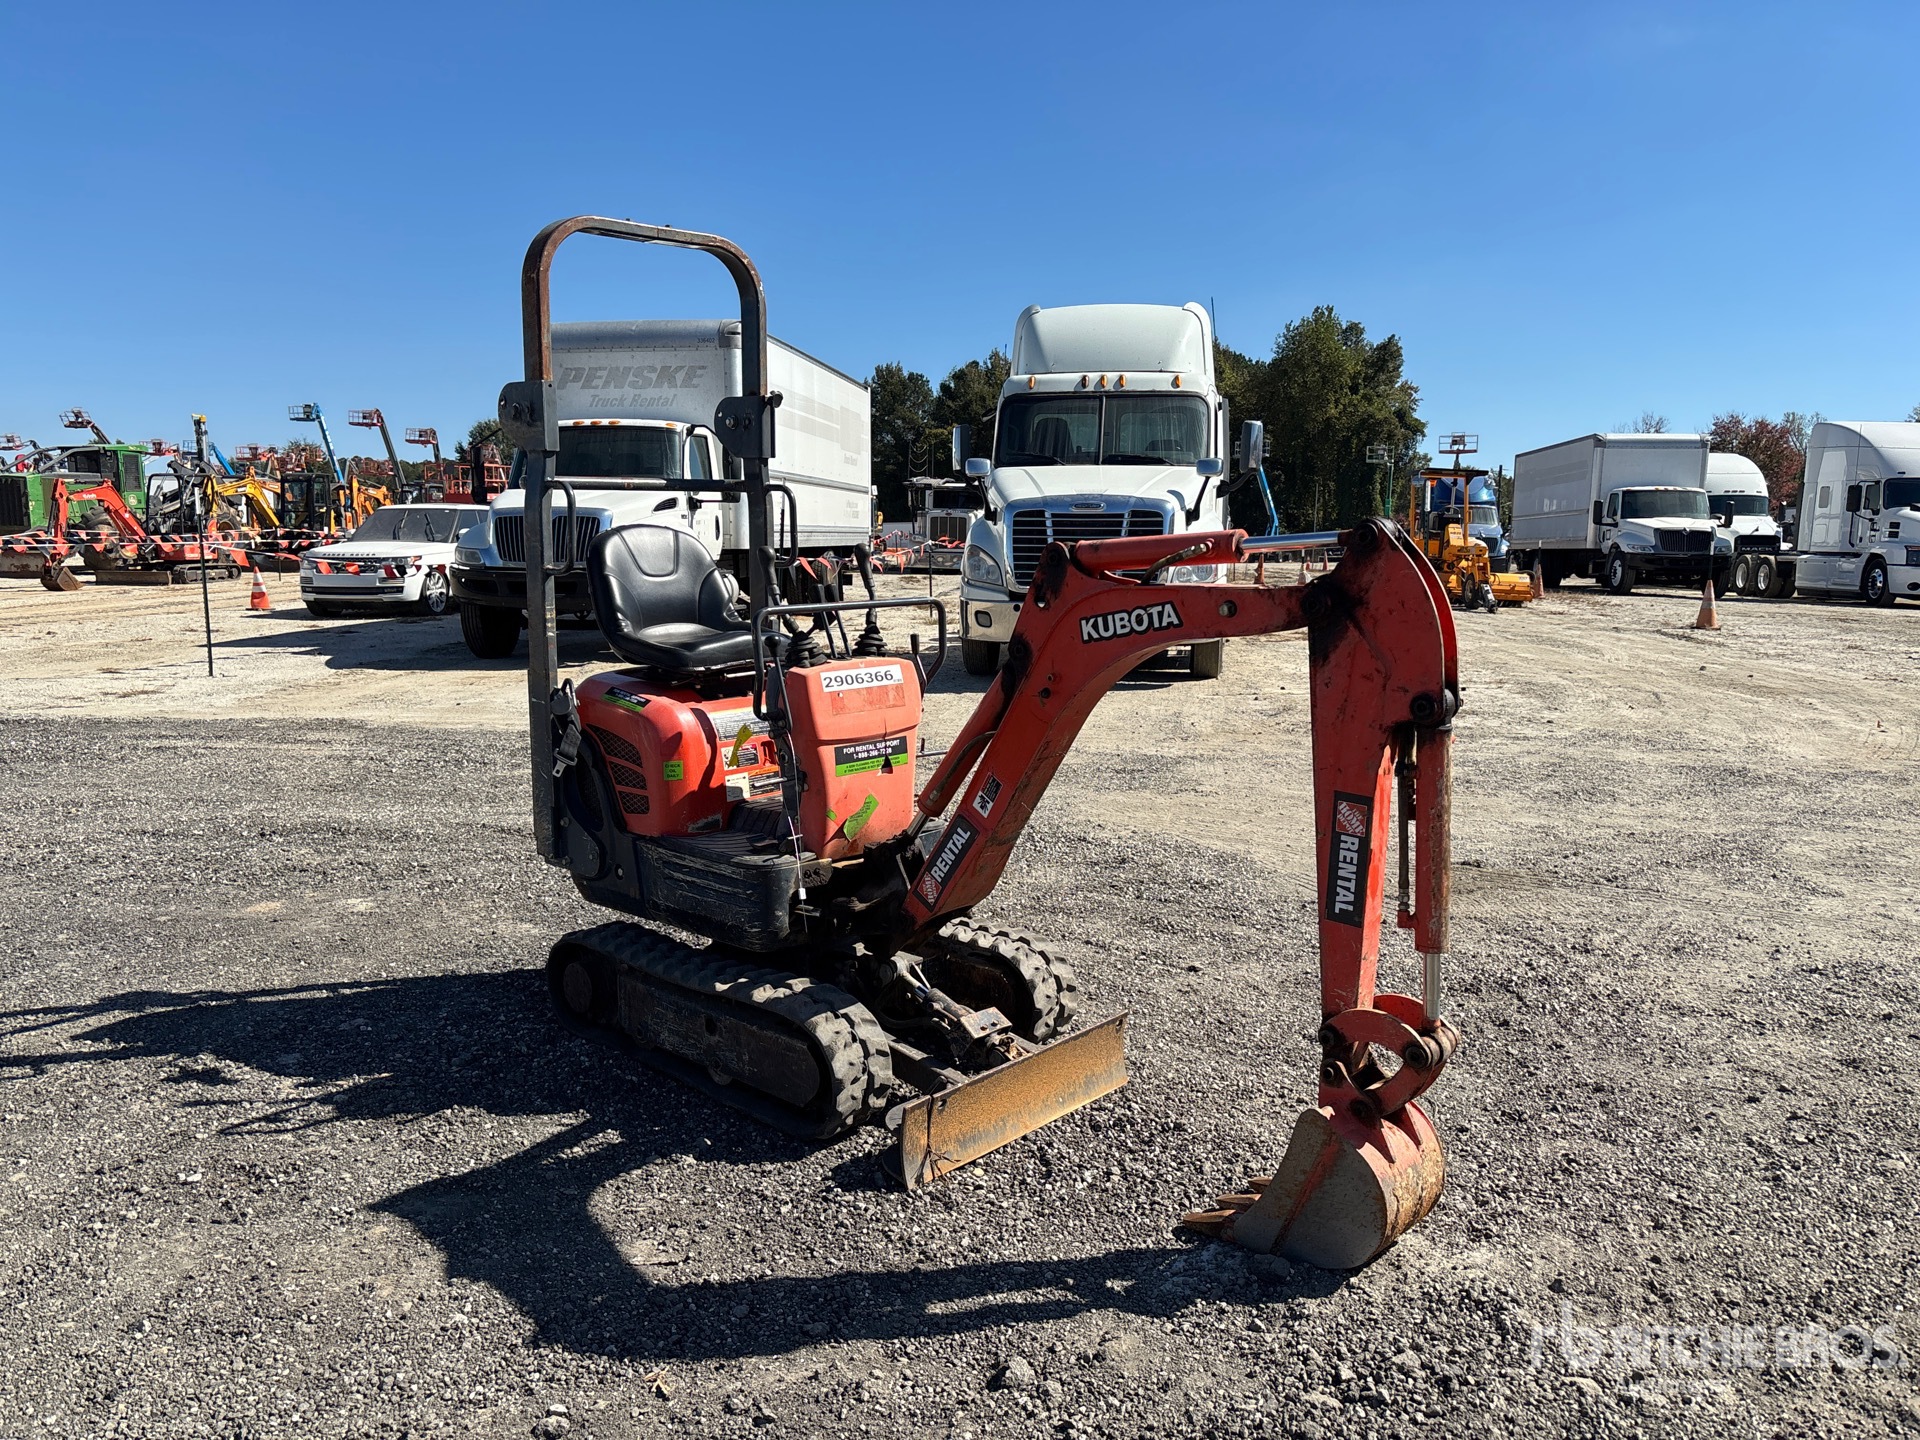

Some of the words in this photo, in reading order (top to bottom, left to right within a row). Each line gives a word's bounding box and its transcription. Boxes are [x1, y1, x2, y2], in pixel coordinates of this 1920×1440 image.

[556, 365, 707, 390] PENSKE
[589, 394, 626, 408] Truck
[629, 393, 677, 408] Rental
[1081, 603, 1180, 641] KUBOTA
[823, 670, 894, 688] 2906366
[843, 747, 855, 755] FOR
[856, 743, 876, 752] RENTAL
[1338, 802, 1365, 833] HOME
[930, 827, 971, 883] RENTAL
[1334, 834, 1360, 914] RENTAL
